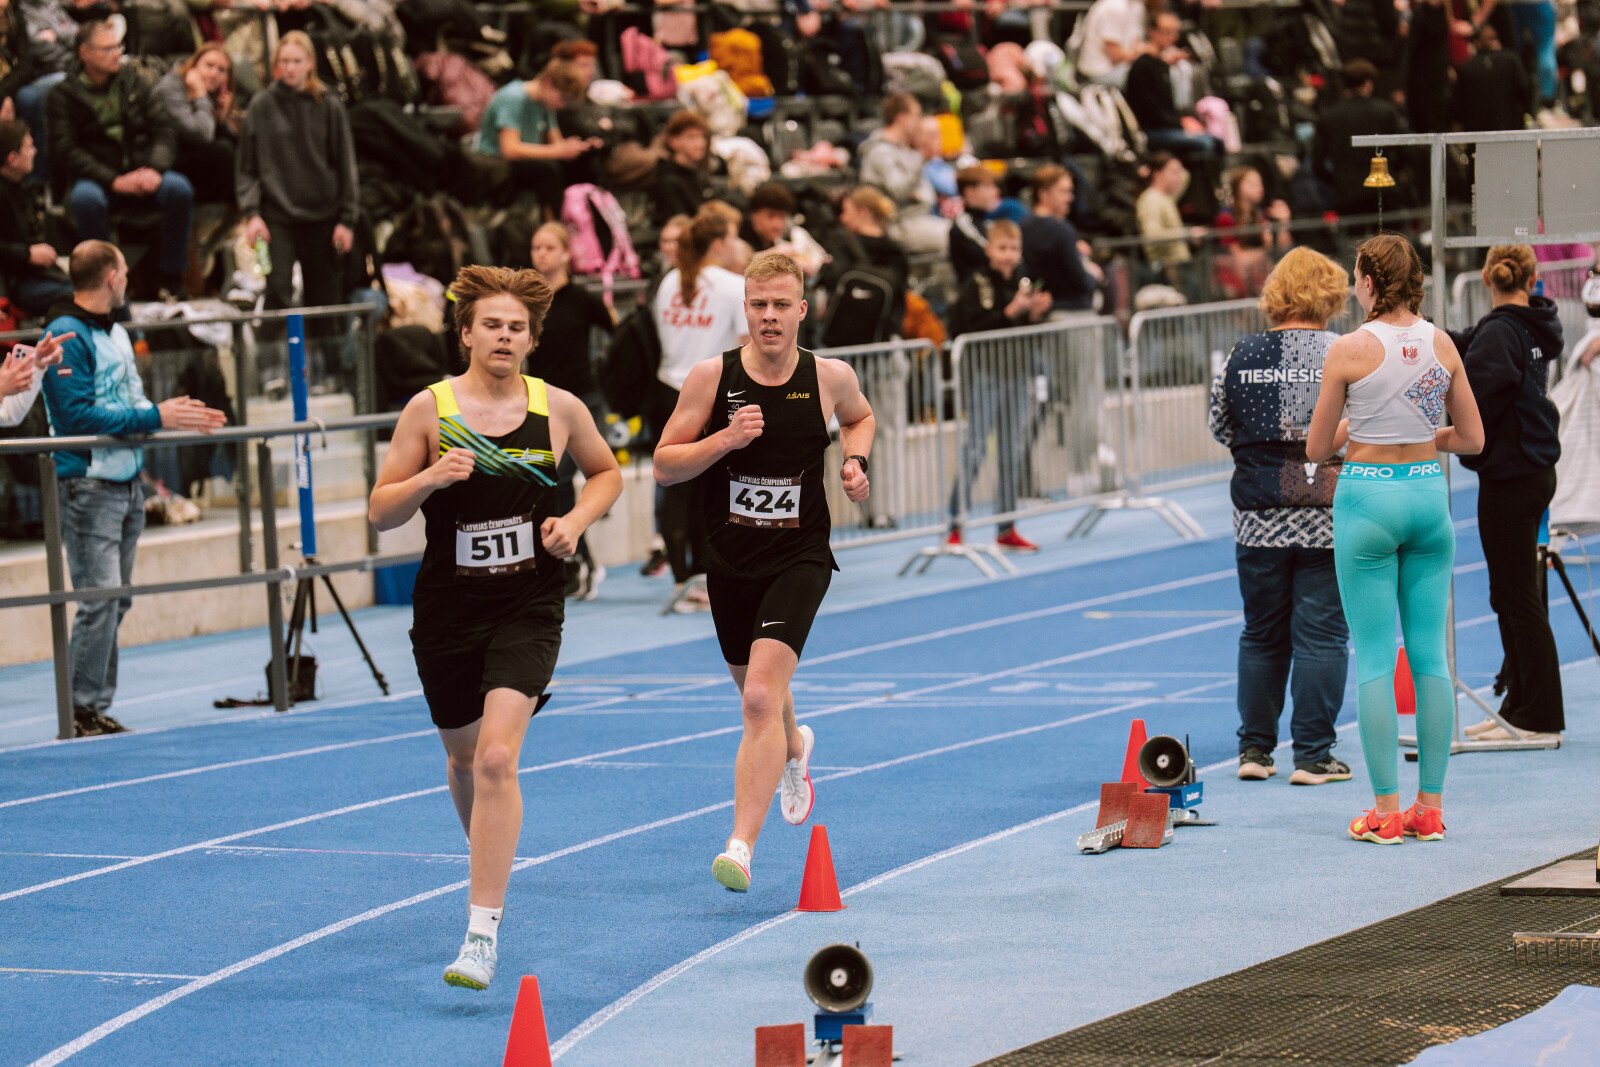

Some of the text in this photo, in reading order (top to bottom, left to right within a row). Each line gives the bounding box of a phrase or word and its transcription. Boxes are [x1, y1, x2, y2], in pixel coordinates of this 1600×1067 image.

[1238, 368, 1323, 384] TIESNESIS
[1350, 466, 1394, 478] PRO
[1407, 462, 1441, 477] PRO
[739, 475, 792, 486] LATVIJAS ČEMPIONĀTS
[735, 487, 795, 513] 424
[463, 515, 523, 532] LATVIJAS ČEMPIONĀTS
[471, 530, 519, 561] 511
